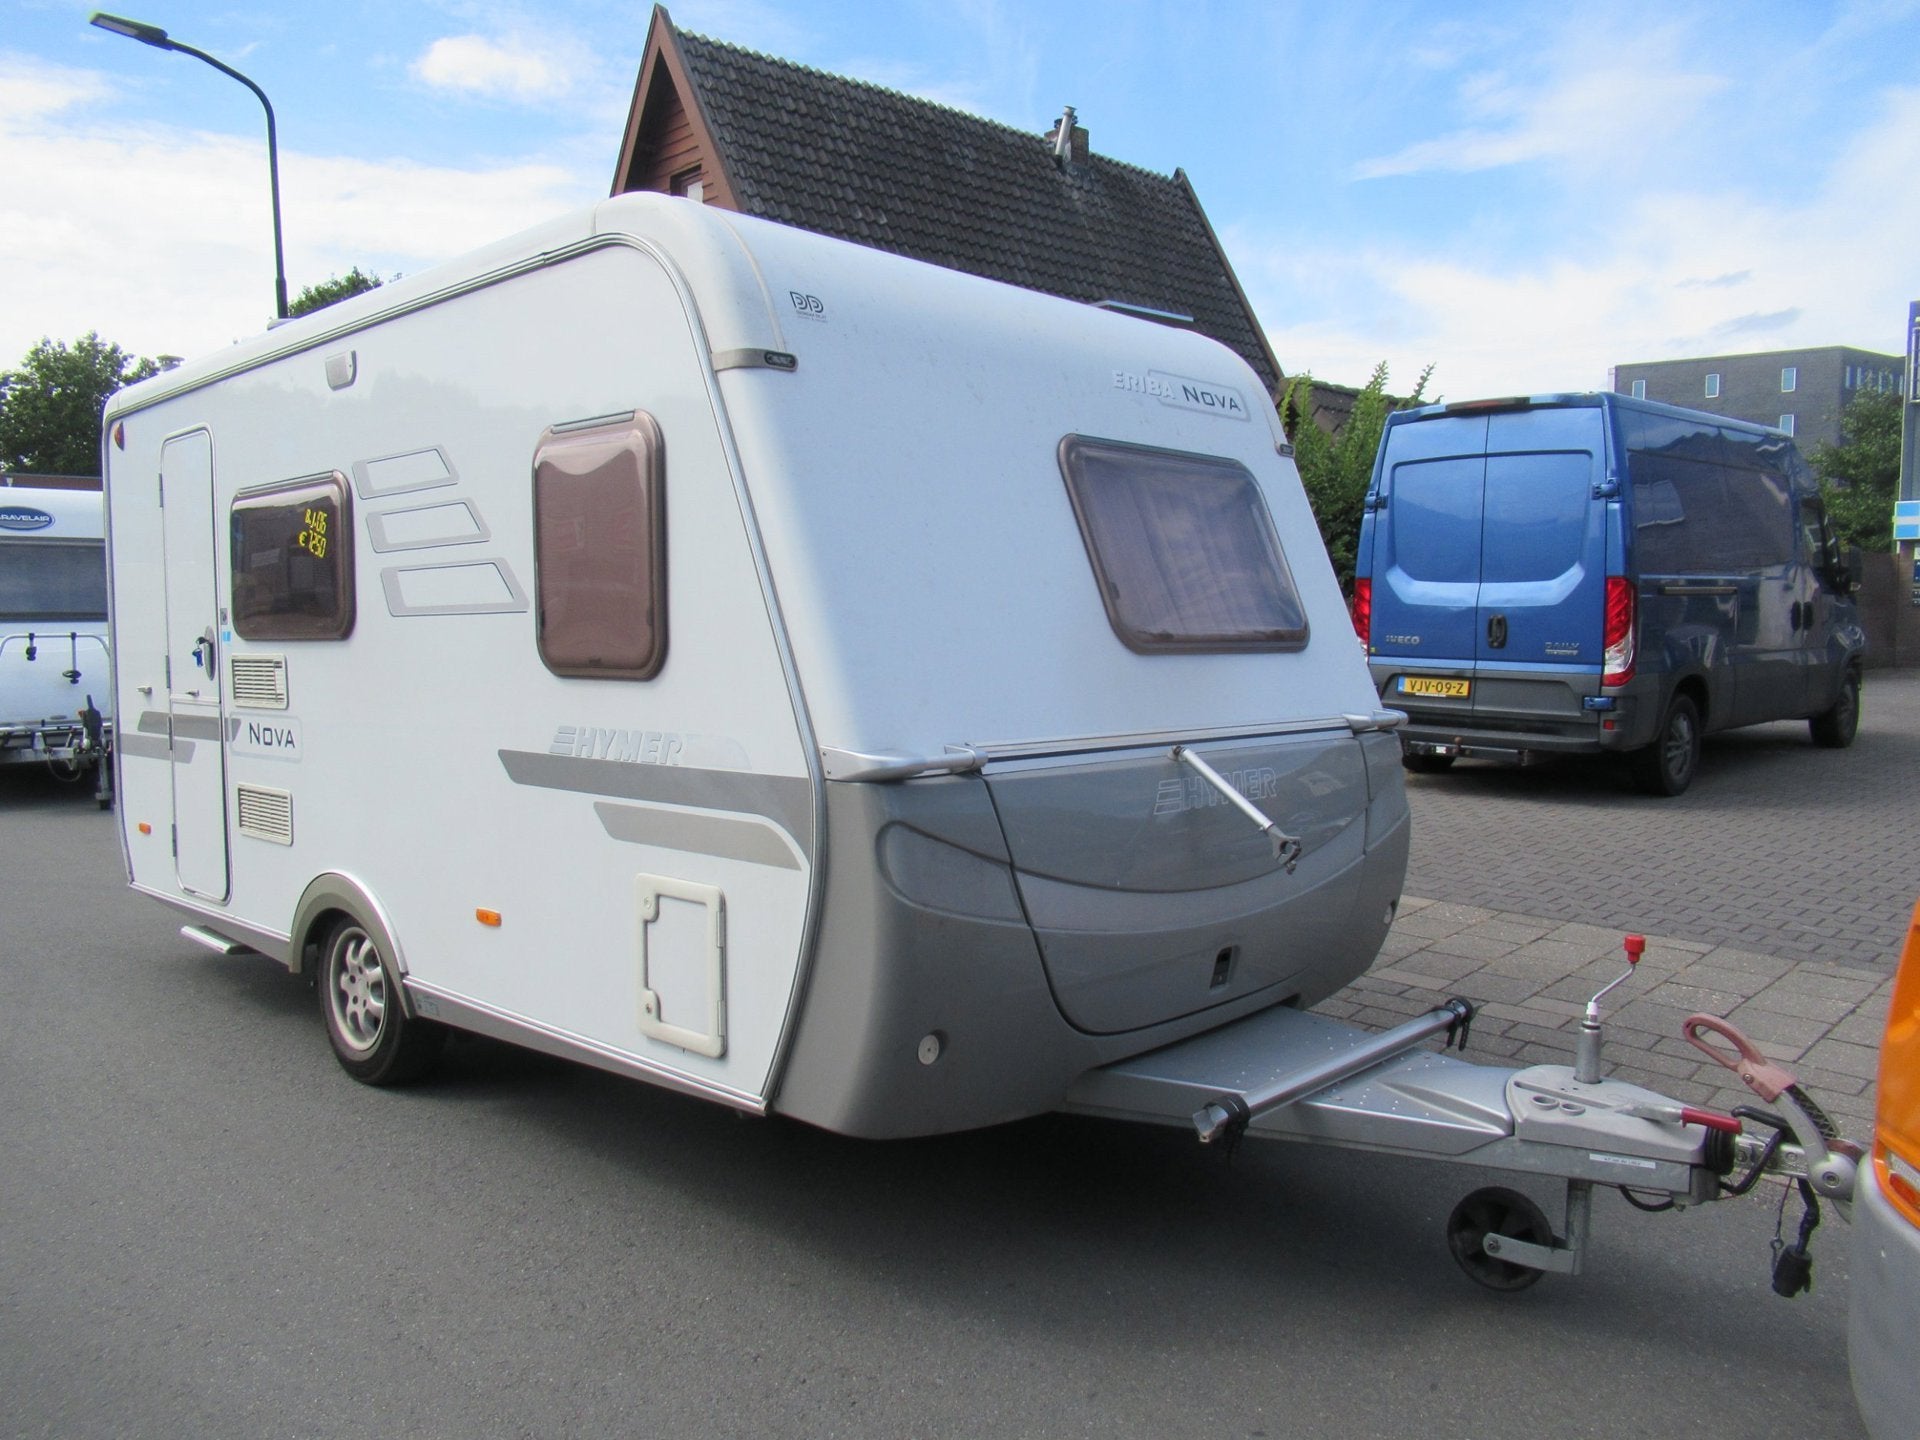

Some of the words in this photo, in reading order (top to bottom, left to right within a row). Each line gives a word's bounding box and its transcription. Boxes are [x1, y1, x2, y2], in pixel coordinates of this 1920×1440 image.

[1113, 371, 1176, 400] ERIBA
[1181, 384, 1242, 412] NOVA
[1385, 634, 1420, 645] IVECO
[1409, 680, 1465, 695] VJV-09-Z
[248, 722, 296, 749] NOVA
[573, 726, 683, 766] HYMER
